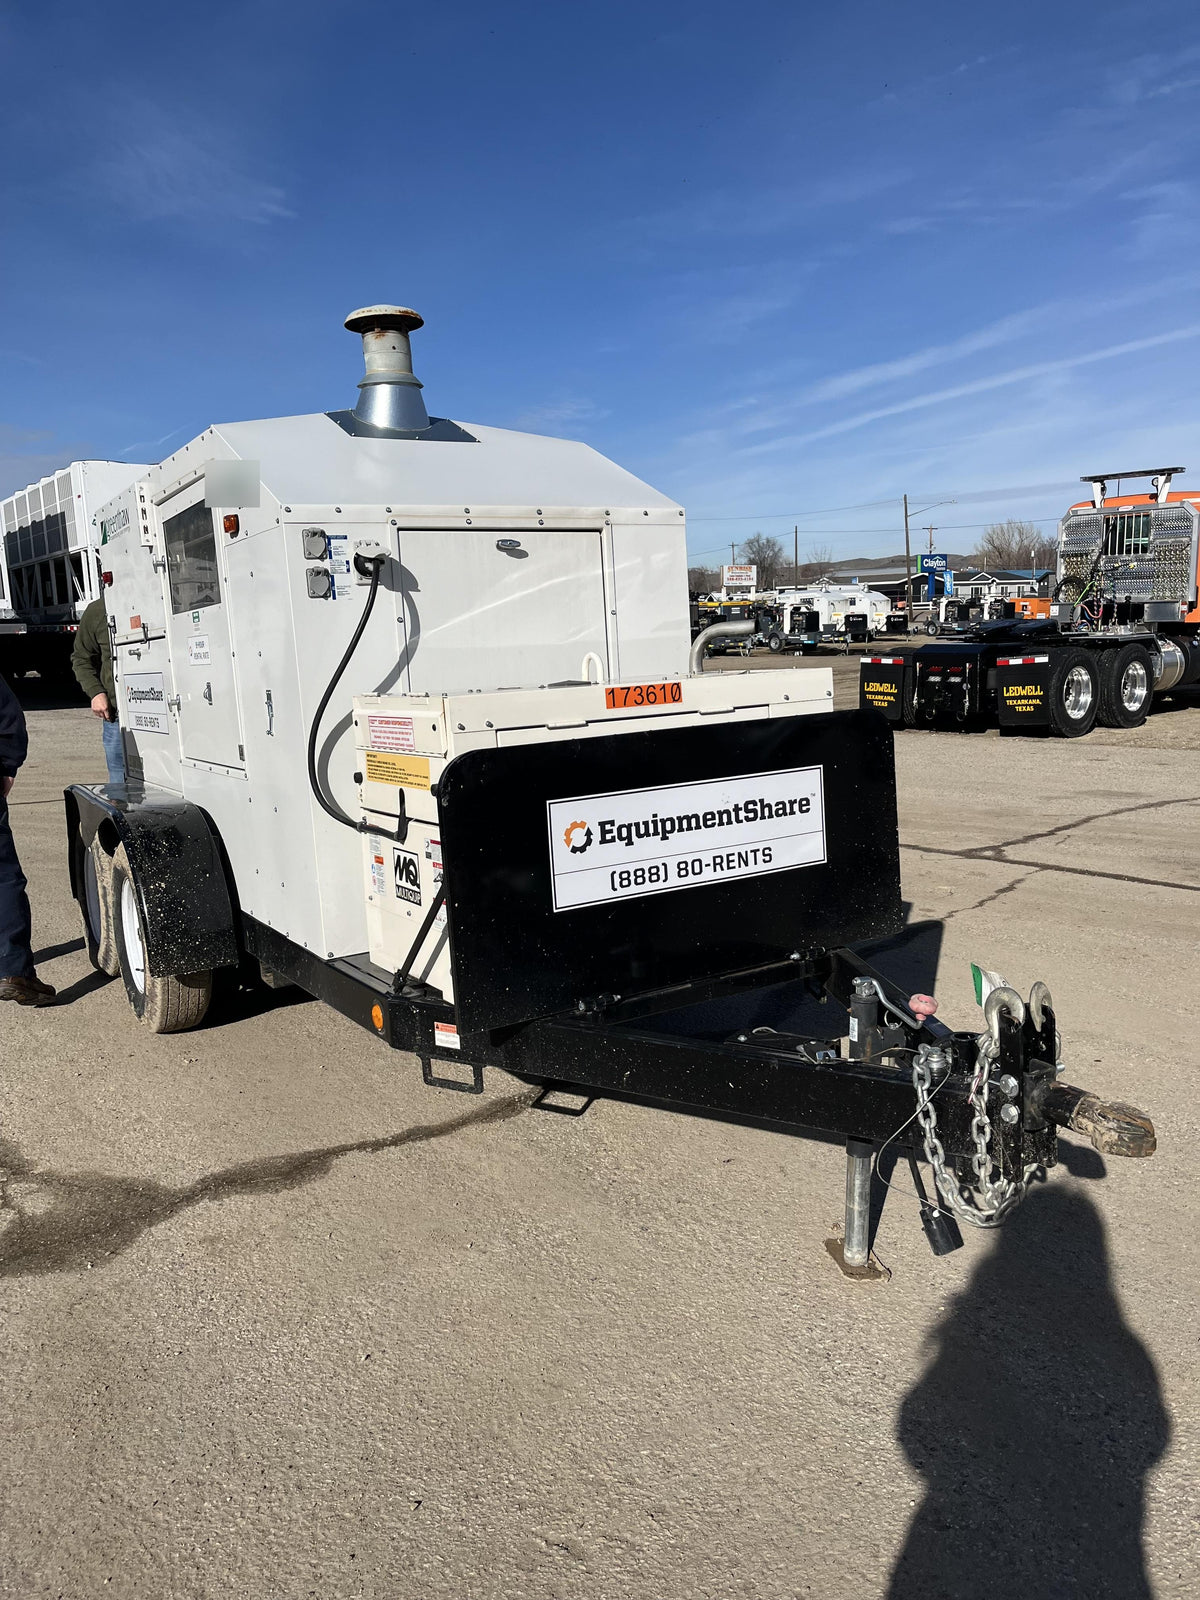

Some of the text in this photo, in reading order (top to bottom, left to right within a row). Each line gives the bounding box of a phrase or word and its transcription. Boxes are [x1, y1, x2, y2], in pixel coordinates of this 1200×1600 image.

[923, 558, 947, 569] Clayton
[864, 682, 898, 693] LEDWELL
[1003, 685, 1044, 697] LEDWELL
[607, 682, 682, 707] 173610
[866, 694, 896, 702] TEXARKANA,
[1006, 698, 1042, 706] TEXARKANA,
[598, 796, 811, 847] EquipmentShare
[395, 854, 420, 889] MQ
[610, 847, 773, 892] (888) 80-RENTS
